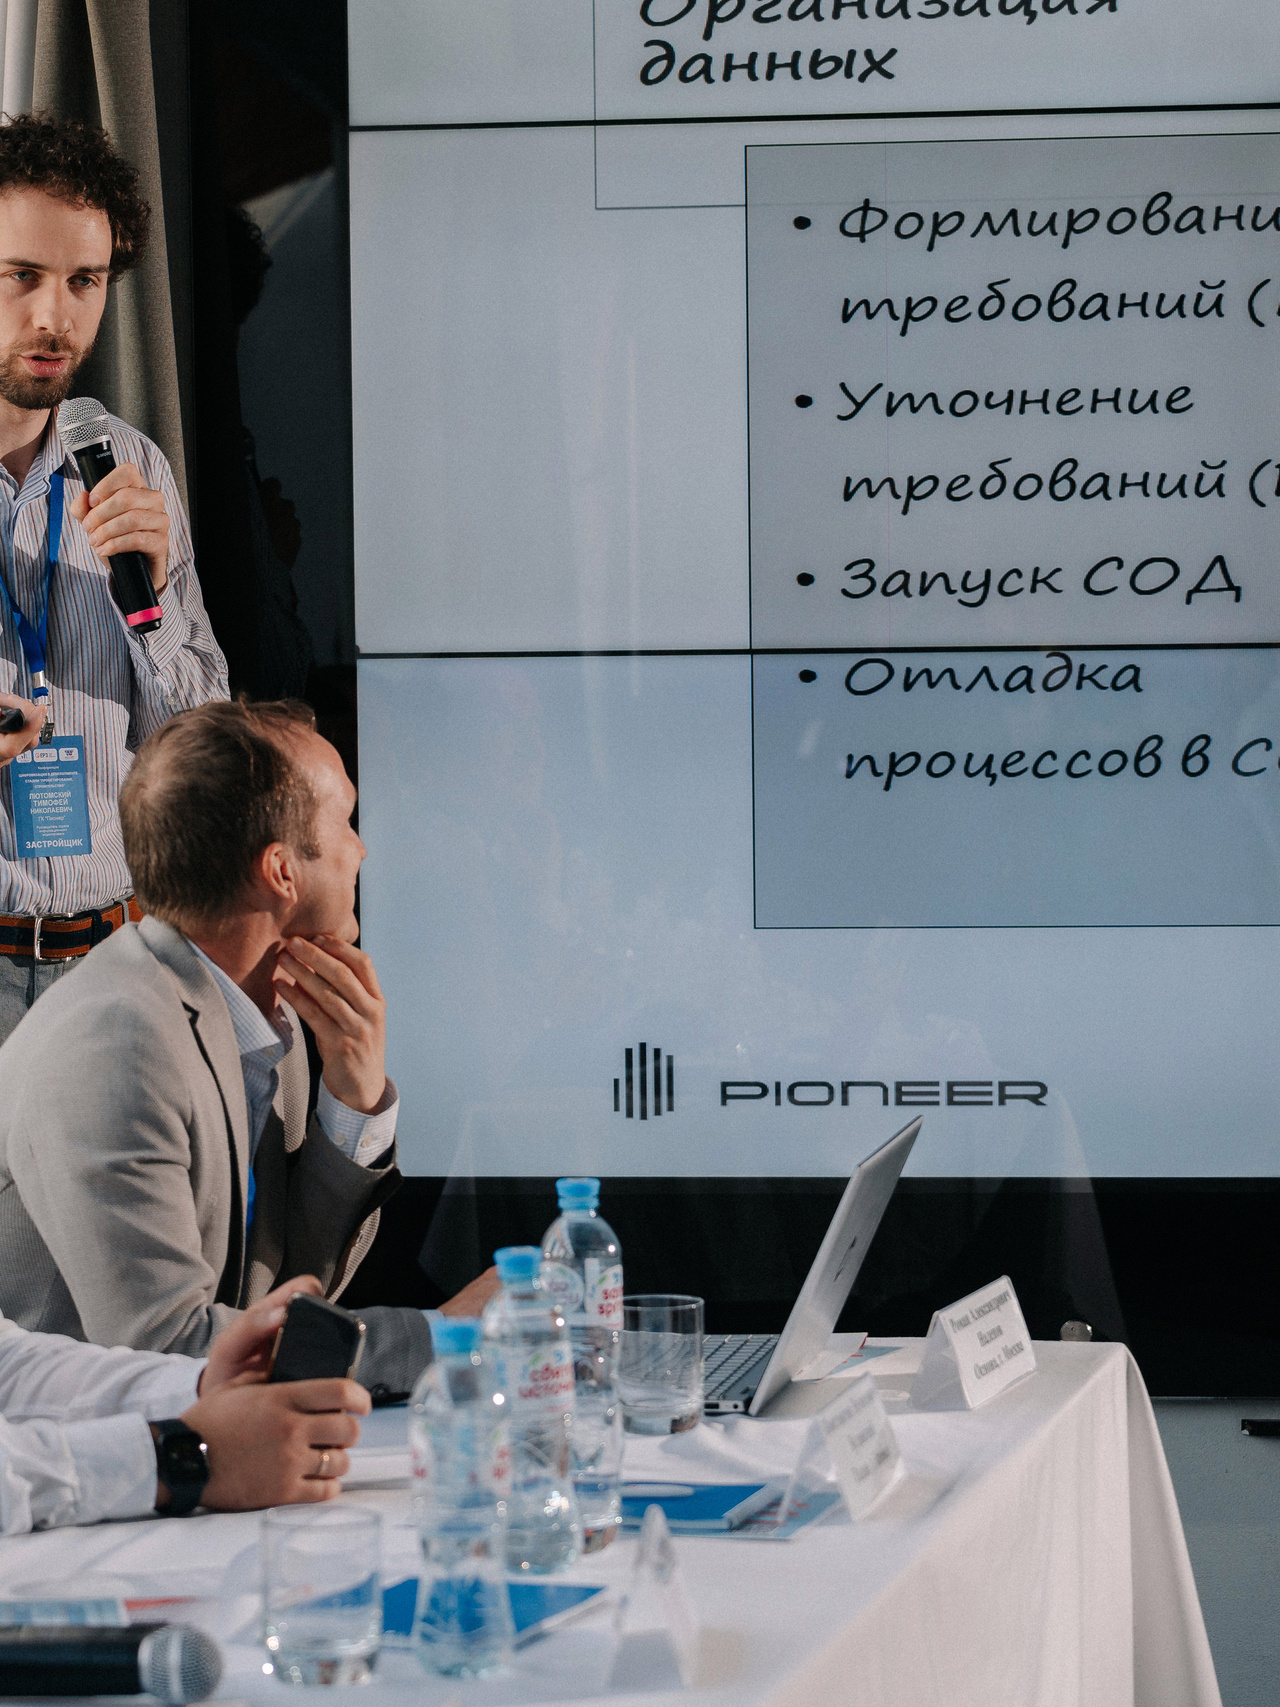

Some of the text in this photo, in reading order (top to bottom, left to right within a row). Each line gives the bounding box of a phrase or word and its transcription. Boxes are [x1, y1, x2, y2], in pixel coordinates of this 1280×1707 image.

[639, 39, 898, 86] данных
[841, 277, 1227, 338] требований
[836, 381, 1194, 422] Уточнение
[843, 457, 1228, 516] требований
[840, 554, 1243, 609] Запуск СОД
[844, 652, 1144, 697] Отладка
[844, 733, 1280, 792] процессов в С
[29, 790, 71, 800] ЛЮТОМСКИЙ
[30, 806, 73, 815] НИКОЛАЕВИЧ
[33, 797, 69, 807] ТИМОФЕЙ
[25, 838, 83, 849] ЗАСТРОЙЩИК
[720, 1080, 1048, 1107] PIONEER
